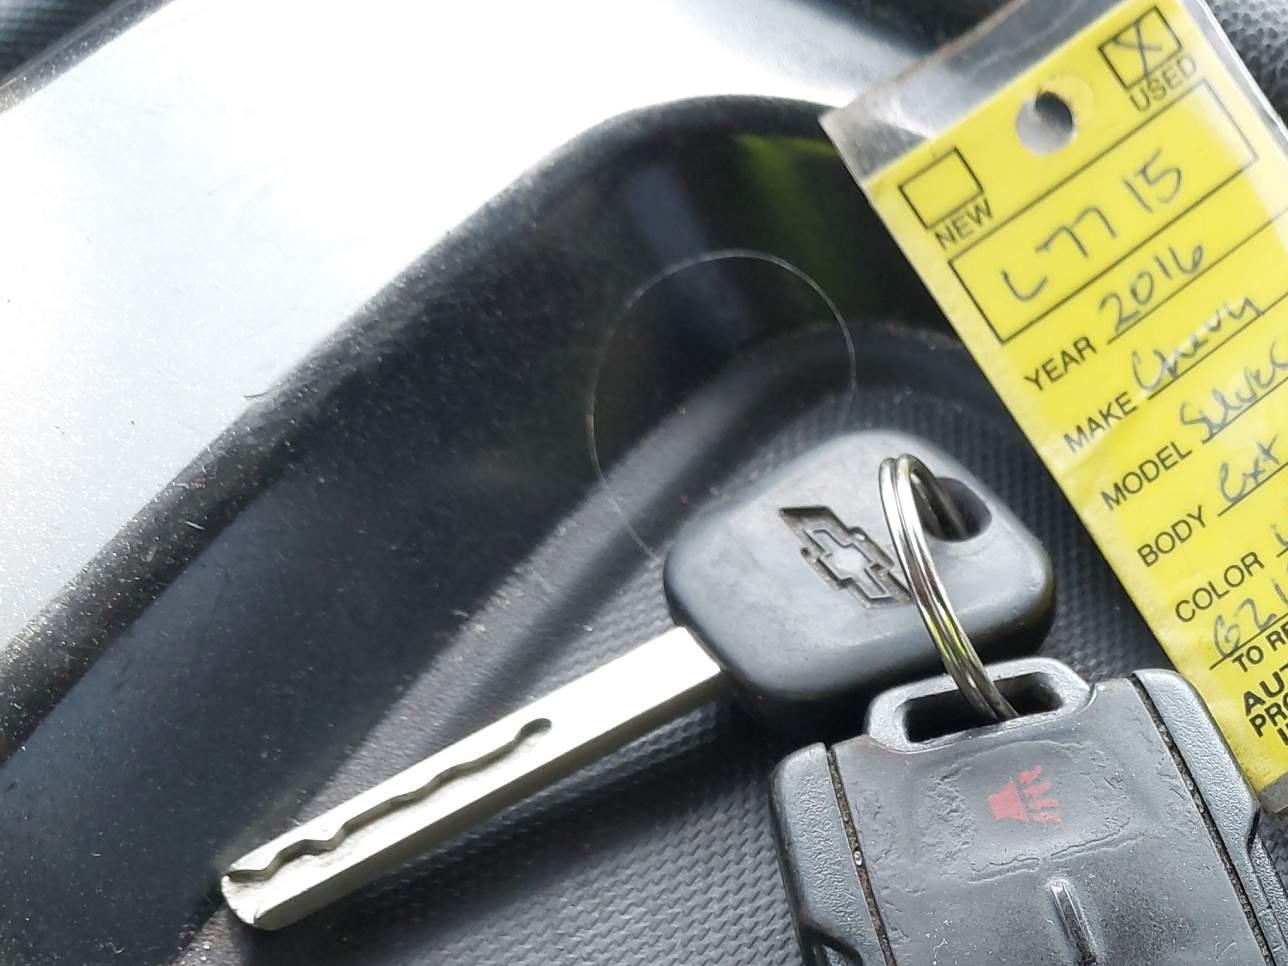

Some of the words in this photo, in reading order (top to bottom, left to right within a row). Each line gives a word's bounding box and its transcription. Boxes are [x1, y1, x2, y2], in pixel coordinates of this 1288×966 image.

[1128, 55, 1198, 113] USED
[932, 198, 994, 251] NEW
[1099, 244, 1204, 332] 2016
[1024, 335, 1097, 392] YEAR
[1062, 391, 1138, 454] MAKE
[1100, 440, 1193, 512] MODEL
[1137, 505, 1207, 567] BODY
[1174, 551, 1266, 623] COLOR
[1232, 645, 1265, 673] TO
